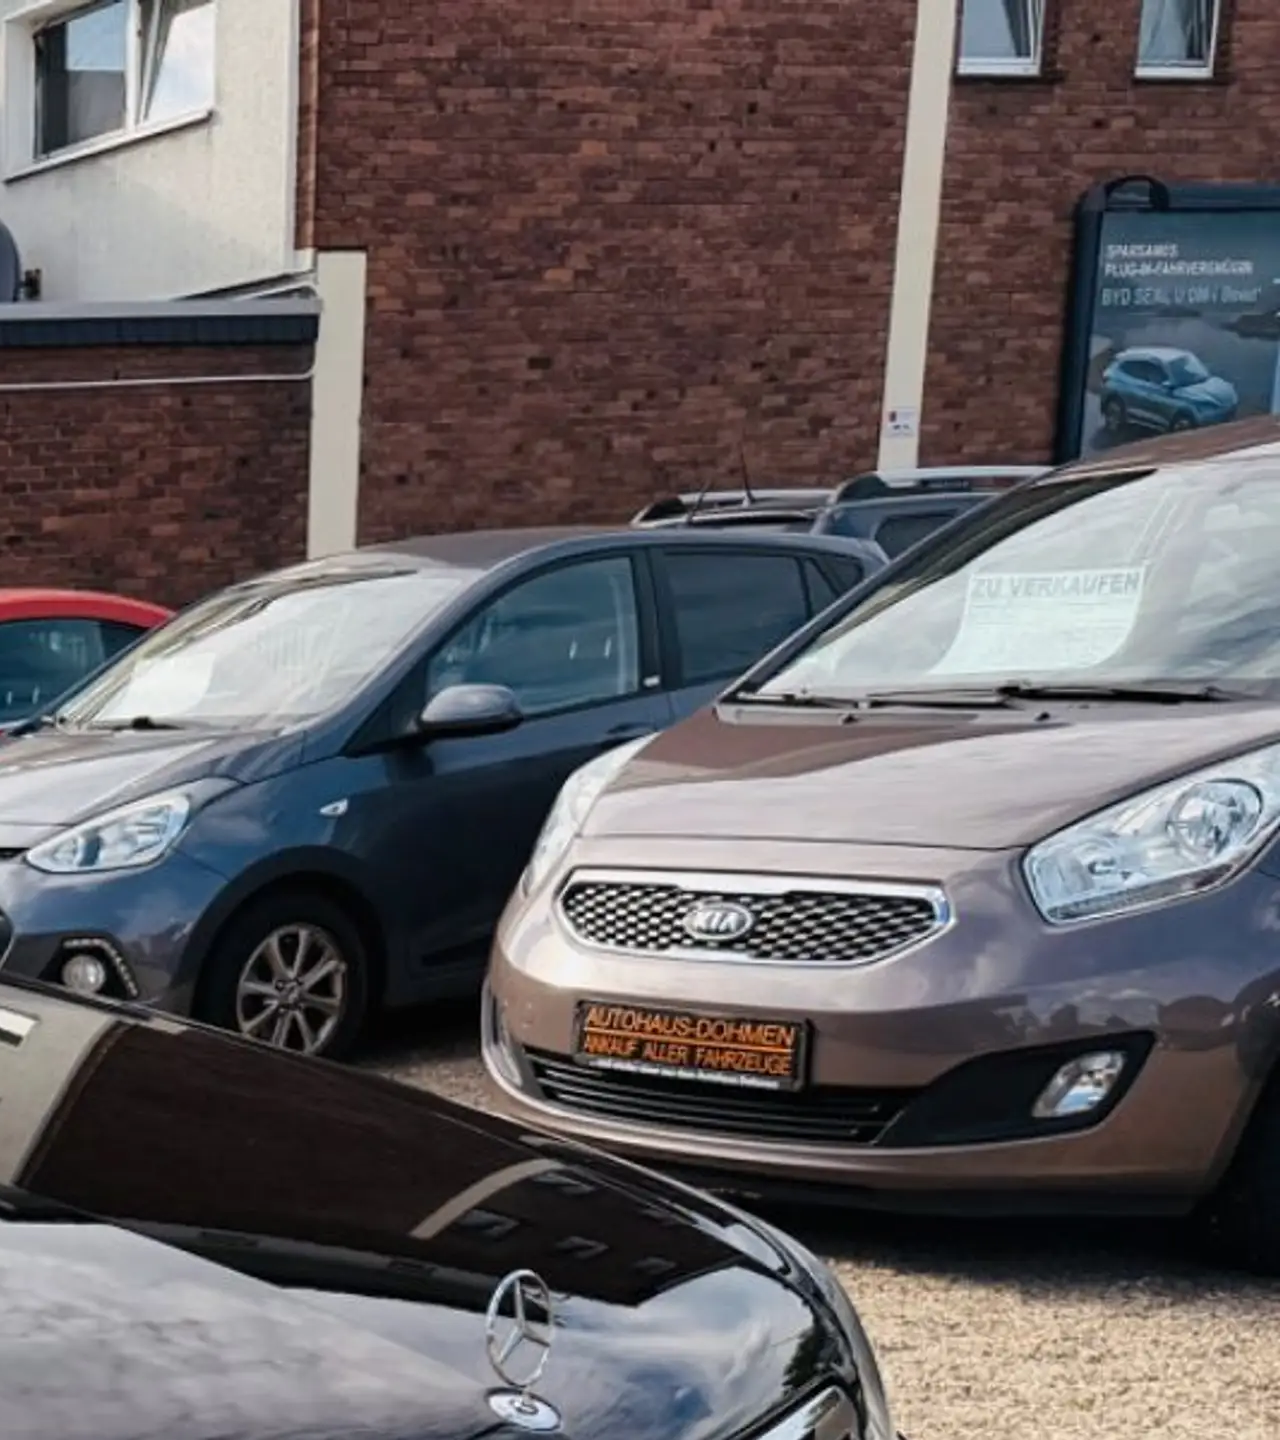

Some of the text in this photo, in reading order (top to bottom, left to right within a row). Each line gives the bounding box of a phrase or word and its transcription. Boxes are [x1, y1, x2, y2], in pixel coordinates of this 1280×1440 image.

[972, 571, 1140, 599] ZU VERKAUFEN
[692, 910, 740, 932] KIA
[643, 1042, 689, 1065] ALLER
[694, 1048, 793, 1075] FAHRZEUGE
